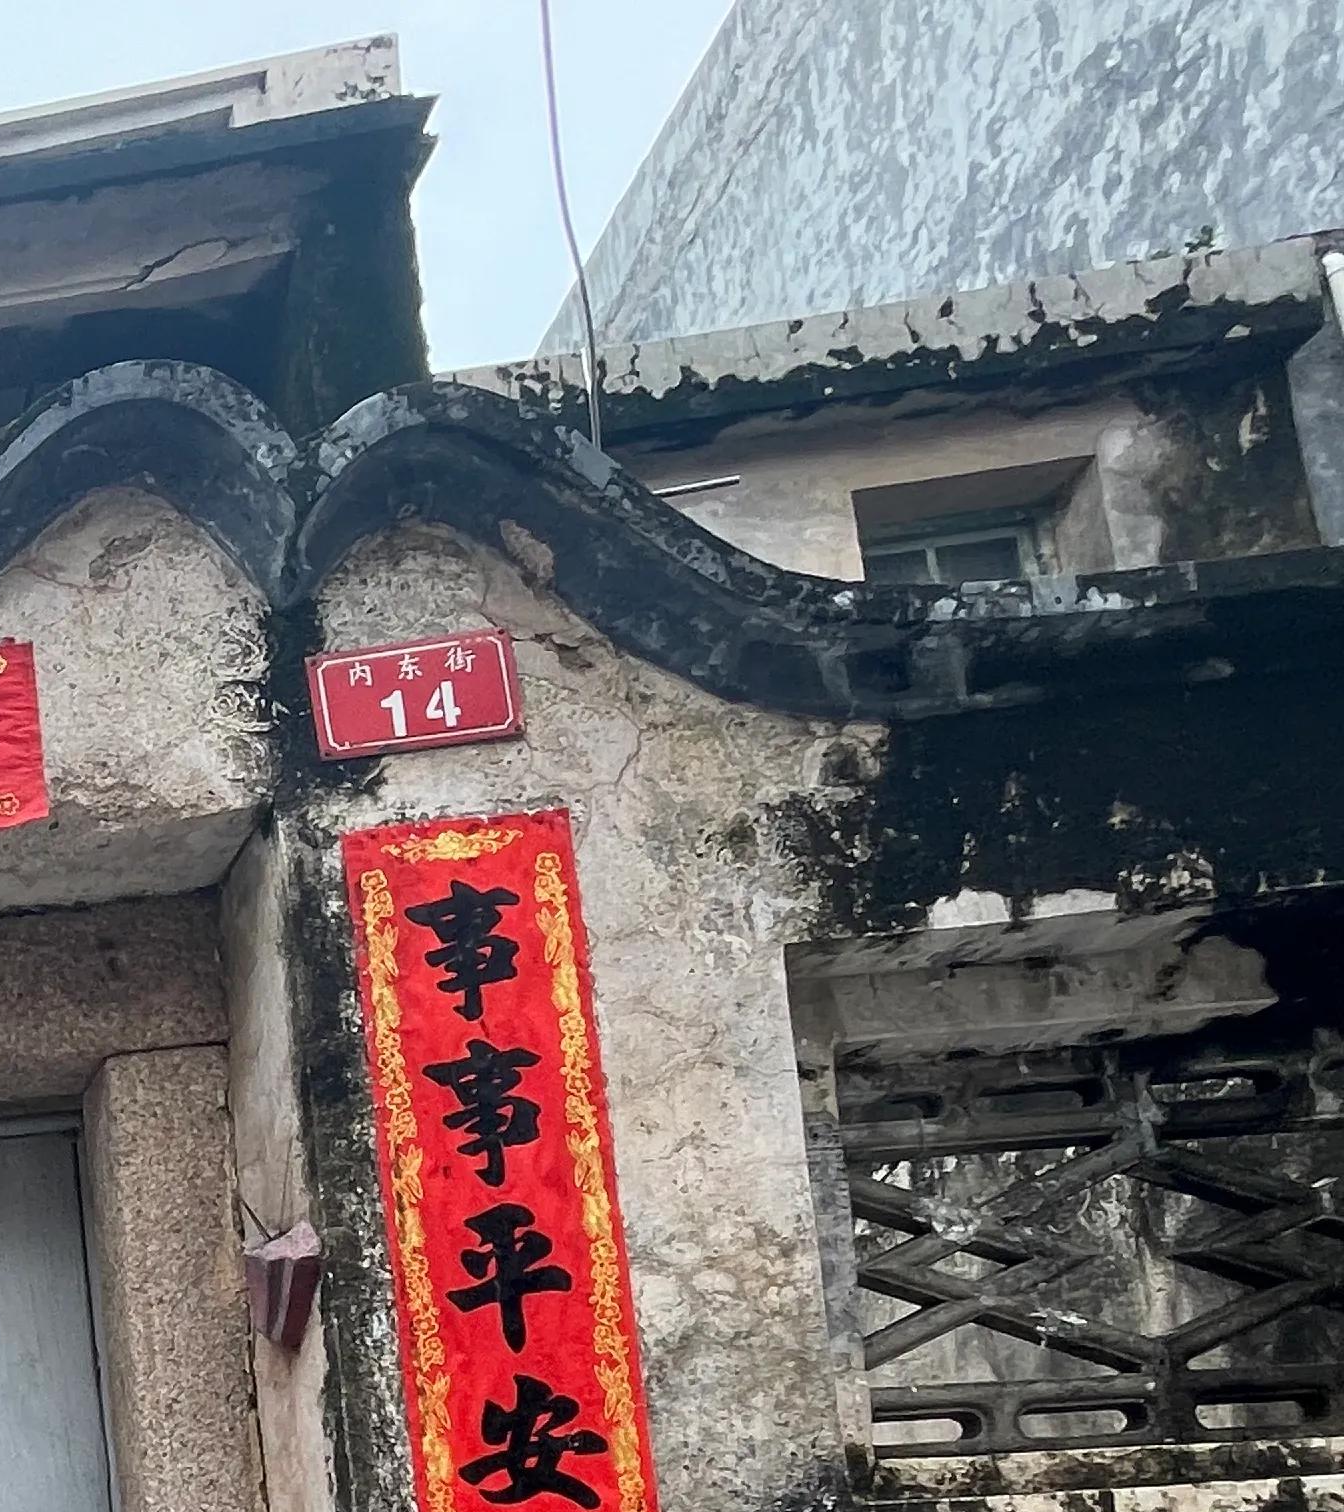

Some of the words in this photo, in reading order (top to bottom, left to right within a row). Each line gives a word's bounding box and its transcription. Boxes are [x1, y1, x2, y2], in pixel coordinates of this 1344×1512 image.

[349, 647, 476, 686] 内东街
[380, 681, 461, 737] 14
